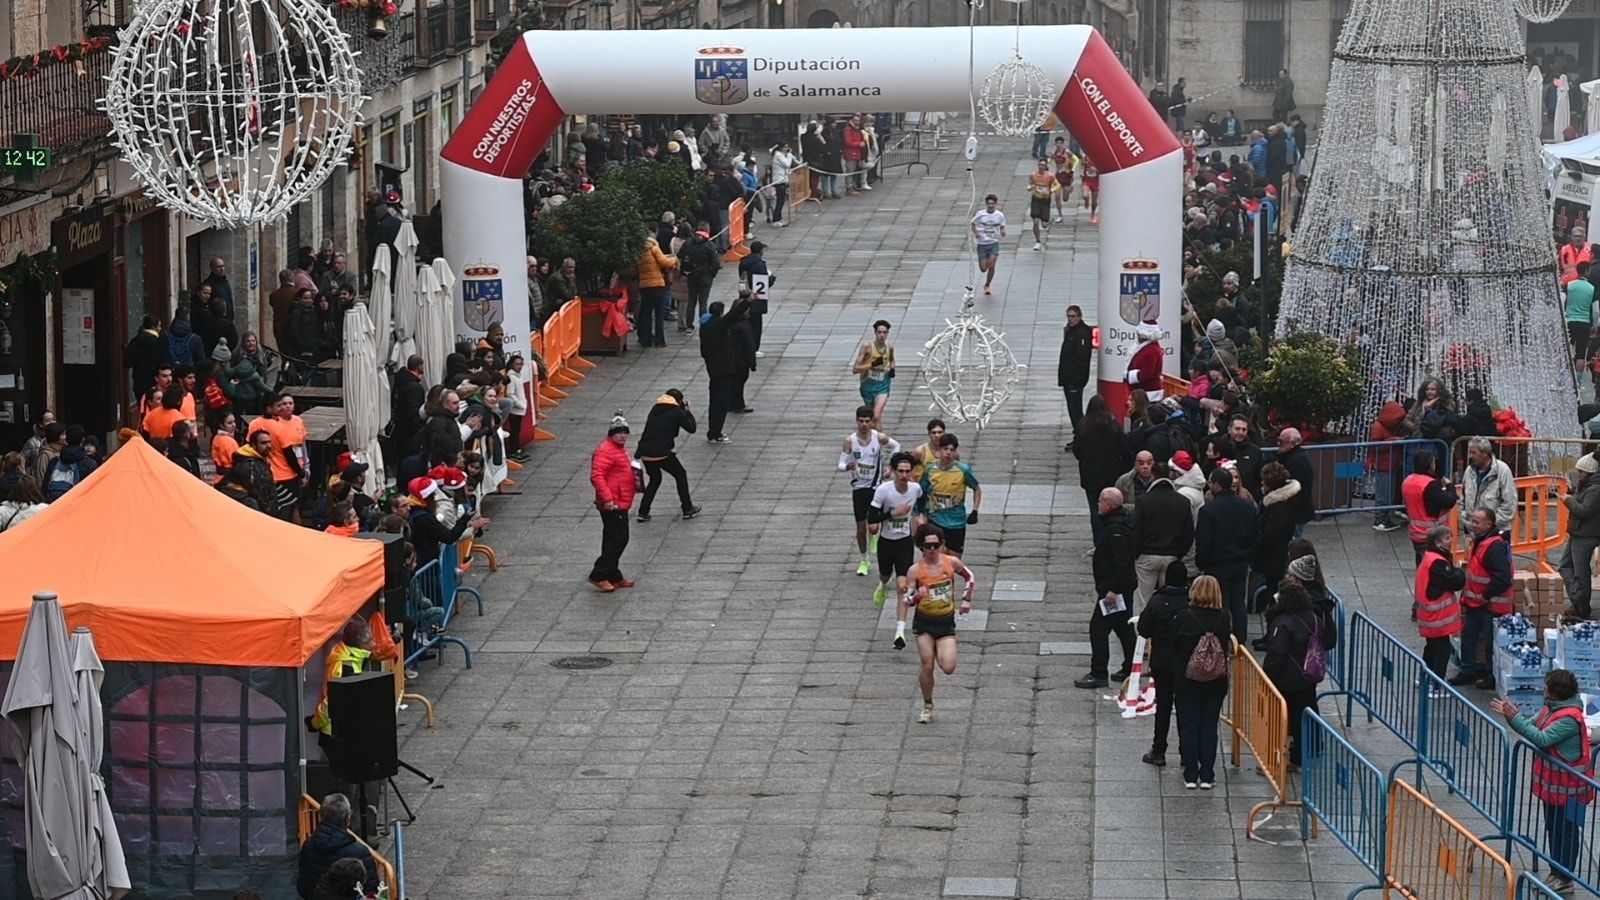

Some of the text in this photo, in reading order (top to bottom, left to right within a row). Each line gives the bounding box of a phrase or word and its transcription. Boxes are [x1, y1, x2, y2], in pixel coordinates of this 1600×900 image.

[753, 56, 861, 74] Diputación
[753, 84, 882, 98] de Salamanca
[472, 78, 533, 160] CON NUESTROS
[483, 93, 537, 164] DEPORTISTAS
[1081, 77, 1144, 157] CON EL DEPORTE
[68, 221, 102, 251] Plaza
[756, 281, 766, 294] 2
